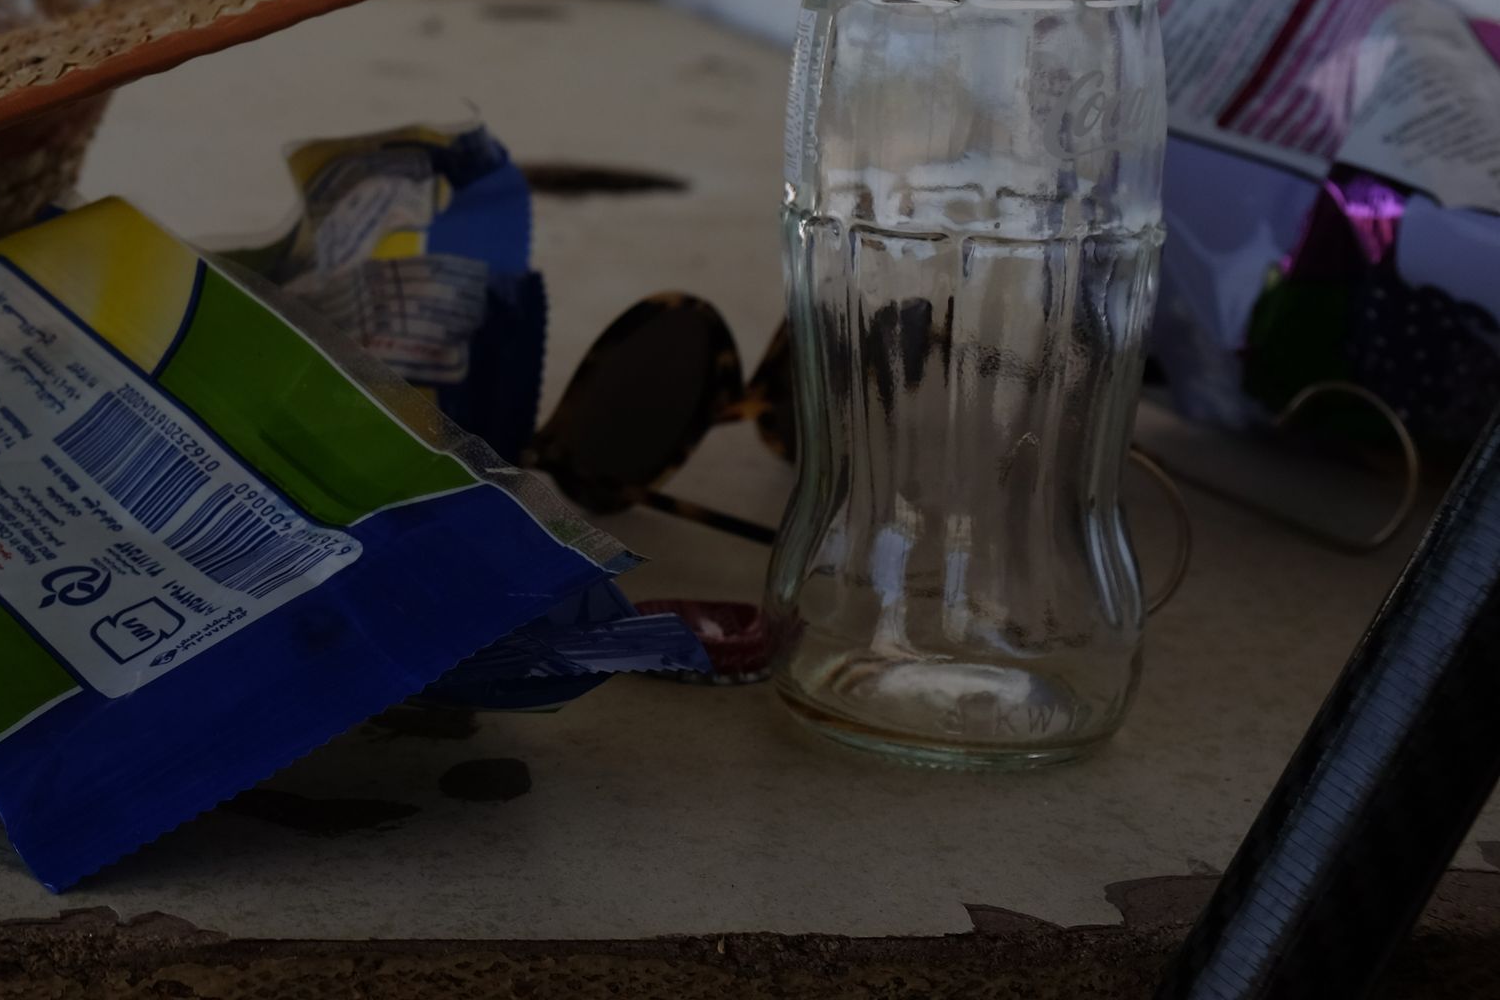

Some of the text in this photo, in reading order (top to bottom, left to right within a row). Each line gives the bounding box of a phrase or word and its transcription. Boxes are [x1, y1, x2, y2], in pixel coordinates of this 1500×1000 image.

[7, 516, 25, 531] of
[8, 537, 22, 547] in
[15, 544, 41, 566] Keep
[35, 543, 57, 561] and
